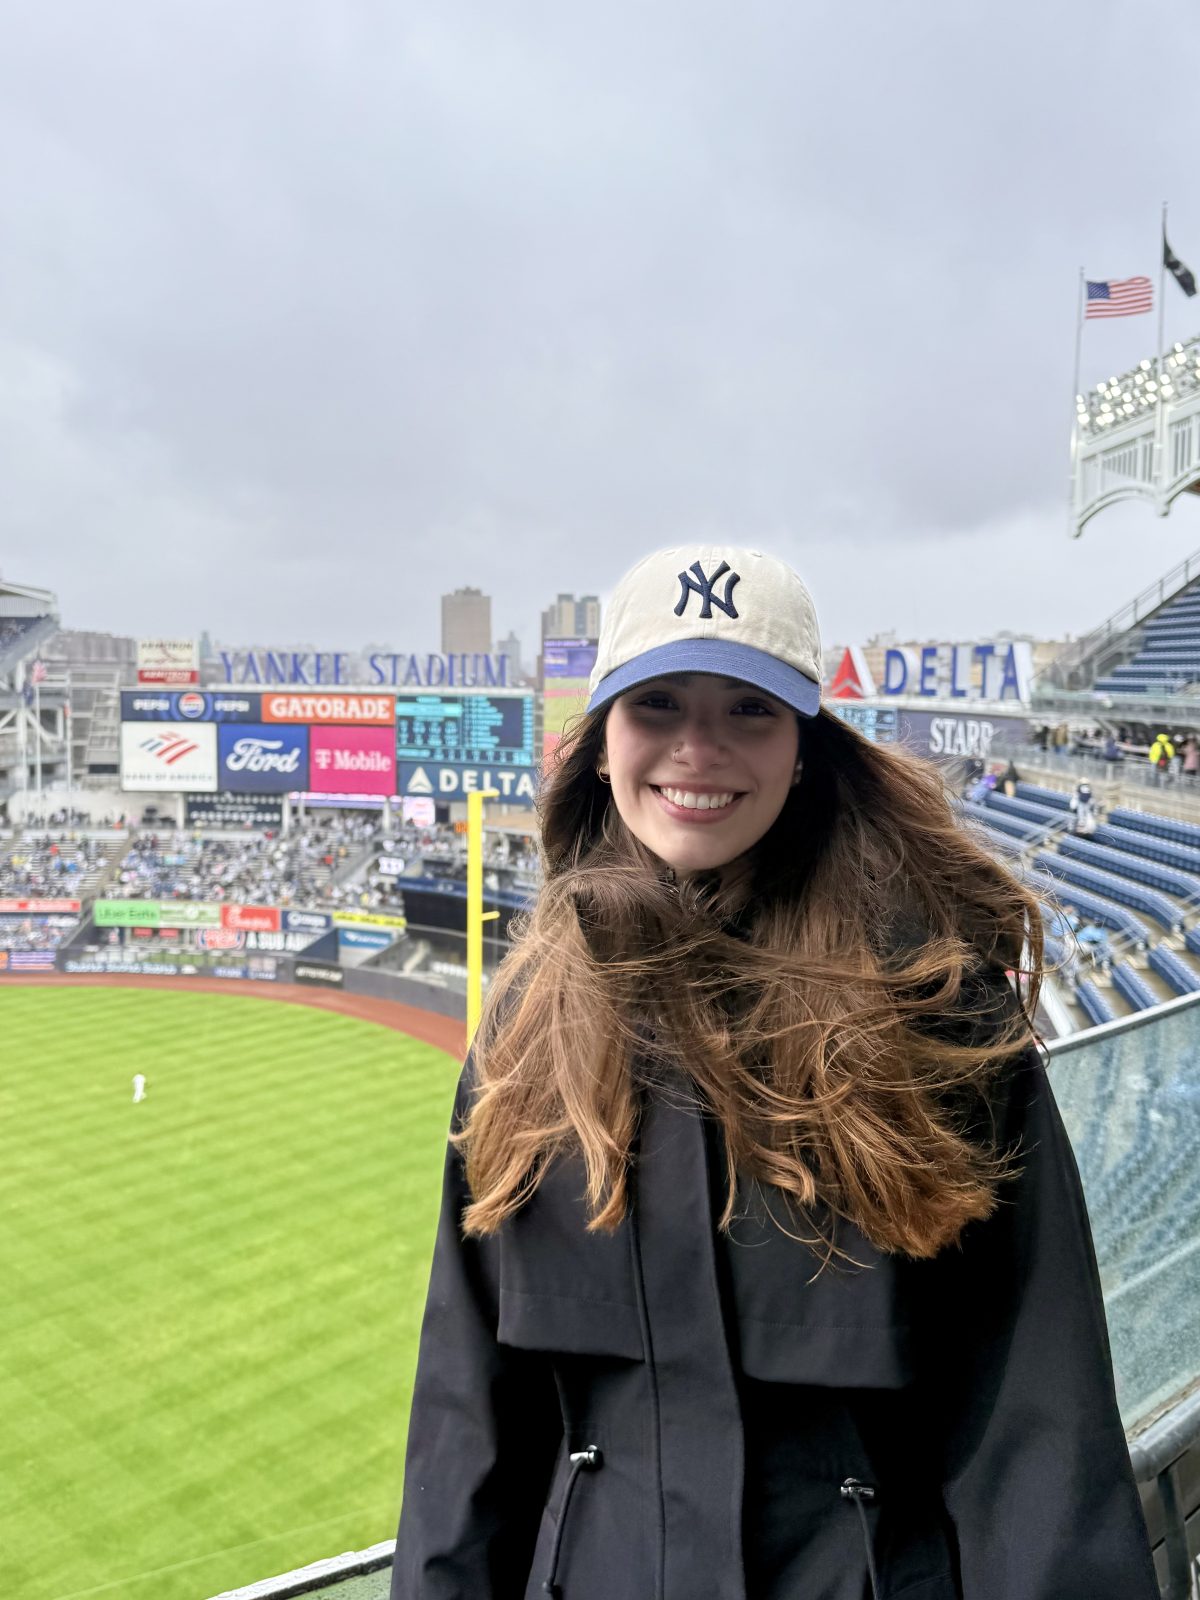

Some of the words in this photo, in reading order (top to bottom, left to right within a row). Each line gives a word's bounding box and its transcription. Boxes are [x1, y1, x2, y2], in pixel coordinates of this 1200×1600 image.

[674, 560, 740, 619] NY
[220, 652, 349, 685] YANKEE
[369, 652, 510, 687] STADIUM
[884, 644, 1025, 701] DELTA
[133, 699, 169, 711] PEPSI
[269, 697, 391, 719] GATORADE
[929, 717, 994, 756] STARR
[226, 737, 301, 773] Ford
[334, 750, 392, 772] Mobile
[439, 768, 536, 797] DELTA
